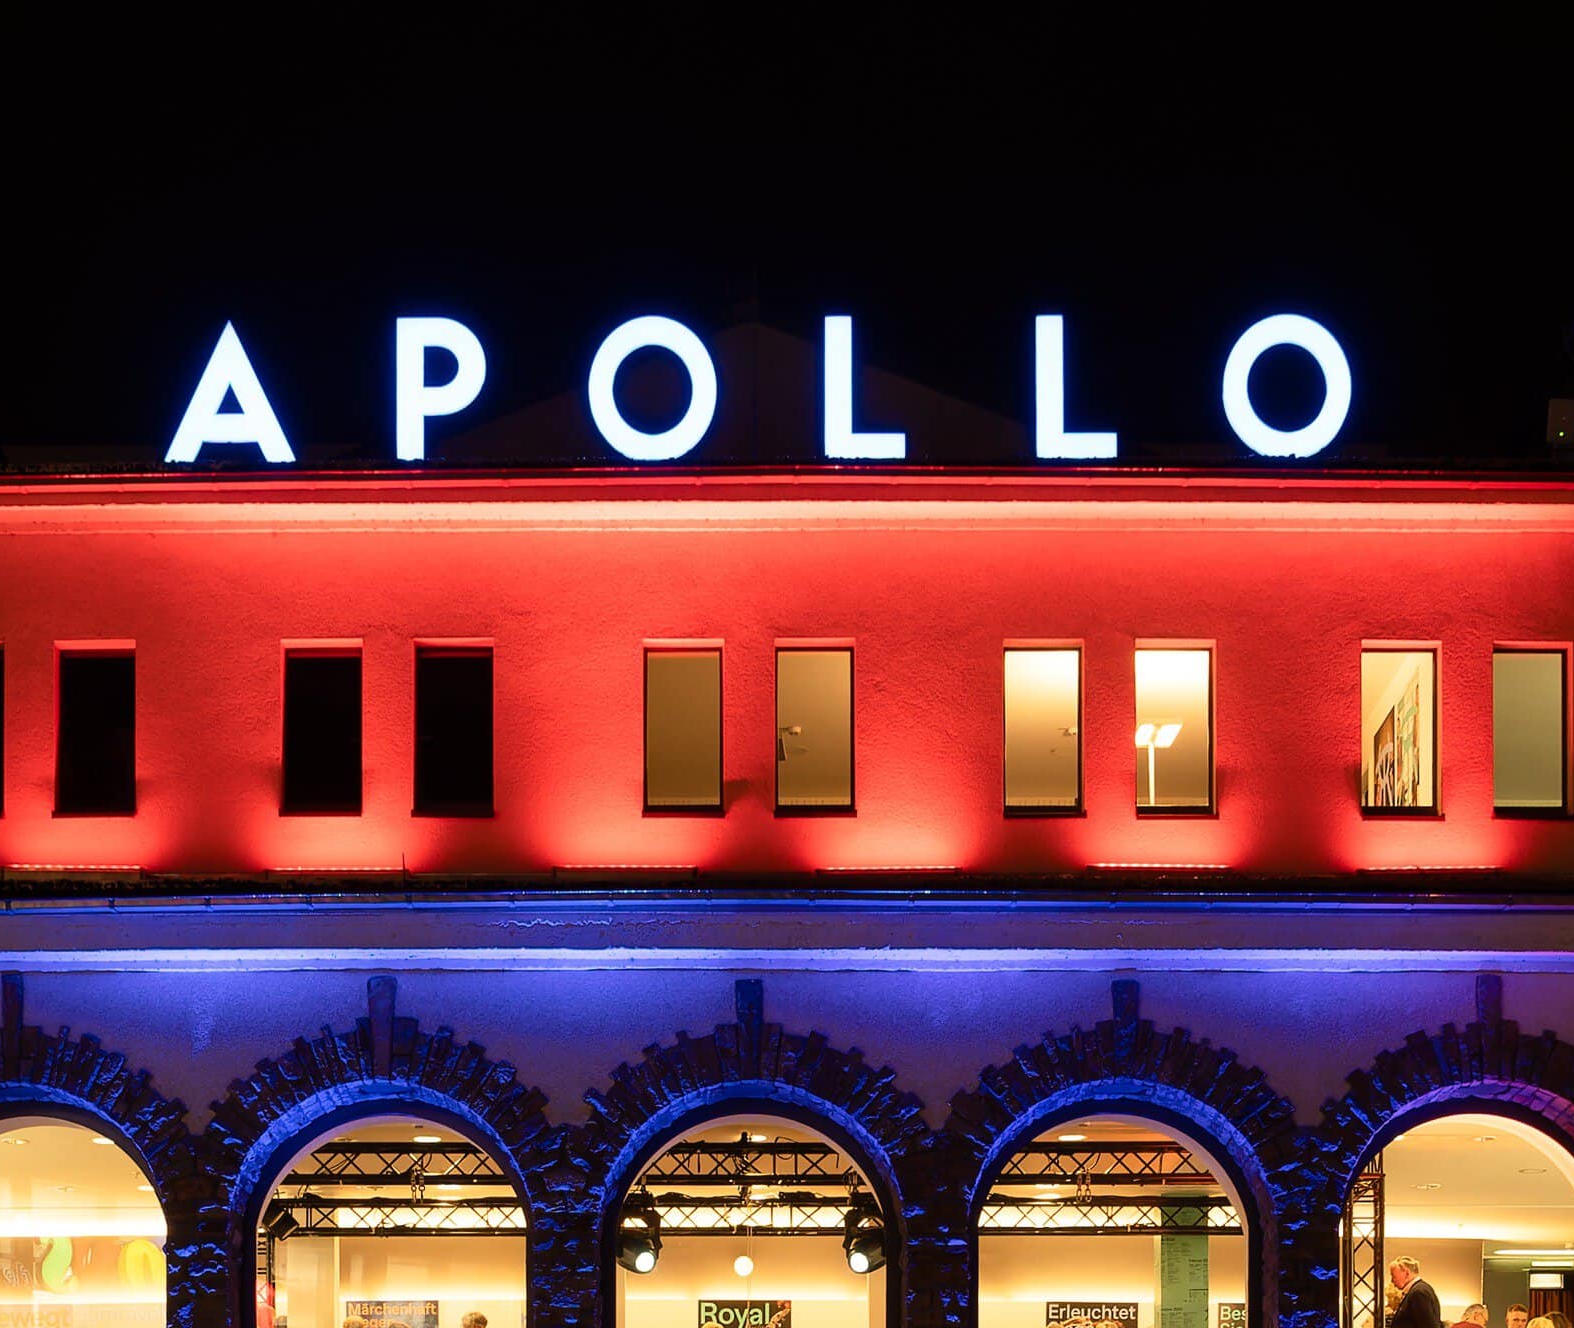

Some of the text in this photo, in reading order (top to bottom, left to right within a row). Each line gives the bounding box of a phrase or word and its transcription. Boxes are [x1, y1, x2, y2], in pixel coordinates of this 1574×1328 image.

[164, 313, 1352, 463] APOLLO
[347, 1302, 437, 1316] Märchenhaft
[1048, 1304, 1137, 1320] Erleuchtet
